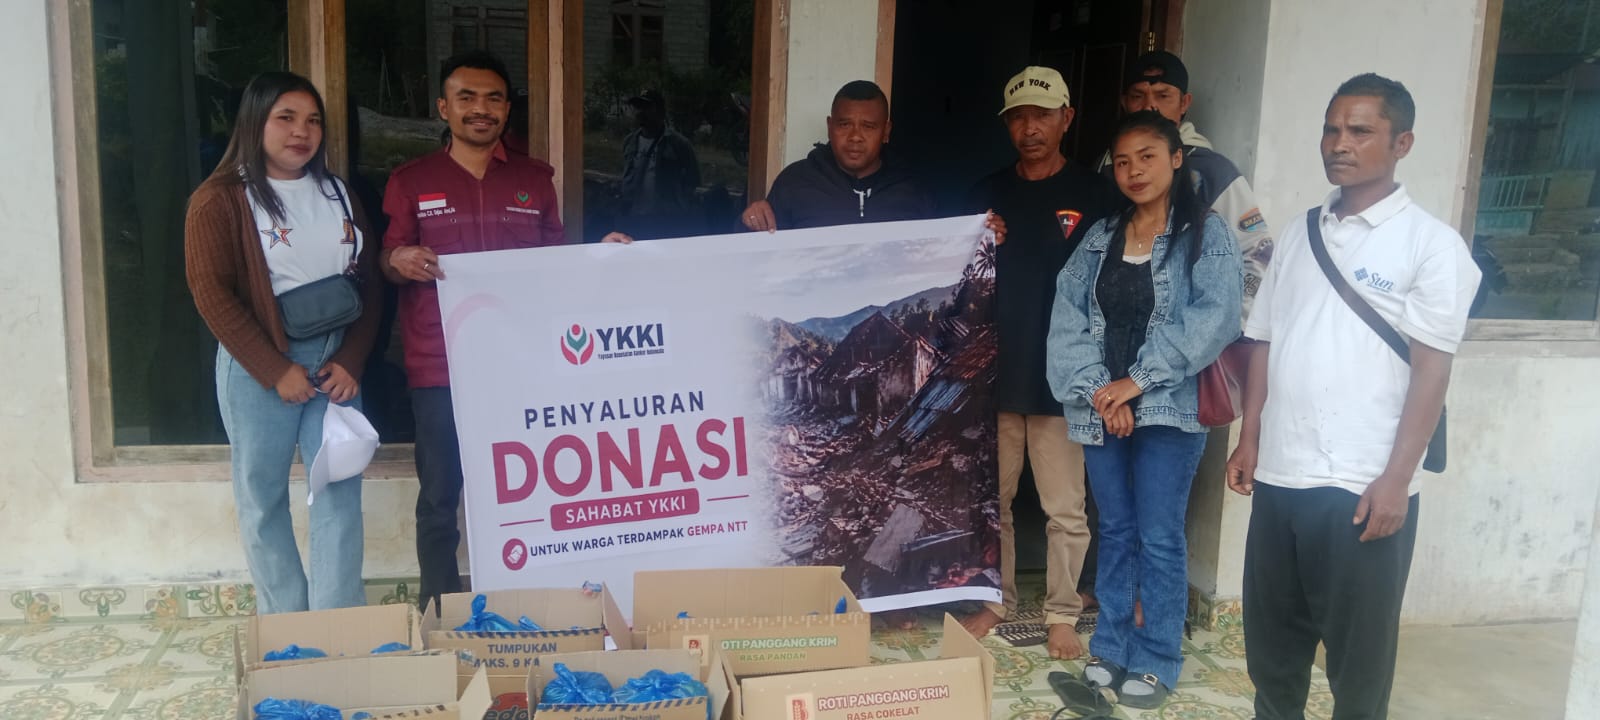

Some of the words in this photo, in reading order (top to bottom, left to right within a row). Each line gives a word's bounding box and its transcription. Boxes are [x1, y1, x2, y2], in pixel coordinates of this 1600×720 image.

[1029, 78, 1051, 91] YORK
[1369, 272, 1393, 290] Sun
[596, 323, 664, 351] YKKI
[524, 391, 704, 429] PENYALURAN
[491, 416, 748, 504] DONASI
[565, 500, 643, 524] SAHABAT
[648, 494, 687, 513] YKKI
[530, 543, 569, 556] UNTUK
[571, 536, 614, 552] WARGA
[617, 528, 685, 545] TERDAMPAK
[686, 522, 725, 537] GEMPA
[727, 520, 748, 532] NTT
[487, 642, 557, 654] TUMPUKAN
[719, 639, 741, 651] OTI
[742, 638, 807, 650] PANGGANG
[808, 636, 838, 647] KRIM
[512, 658, 520, 668] 9
[739, 654, 766, 663] RASA
[767, 652, 807, 661] PANDAN
[817, 696, 848, 711] ROTI
[849, 689, 918, 709] PANGGANG
[918, 685, 950, 700] KRIM
[846, 712, 875, 720] RASA
[875, 706, 921, 720] COKELAT
